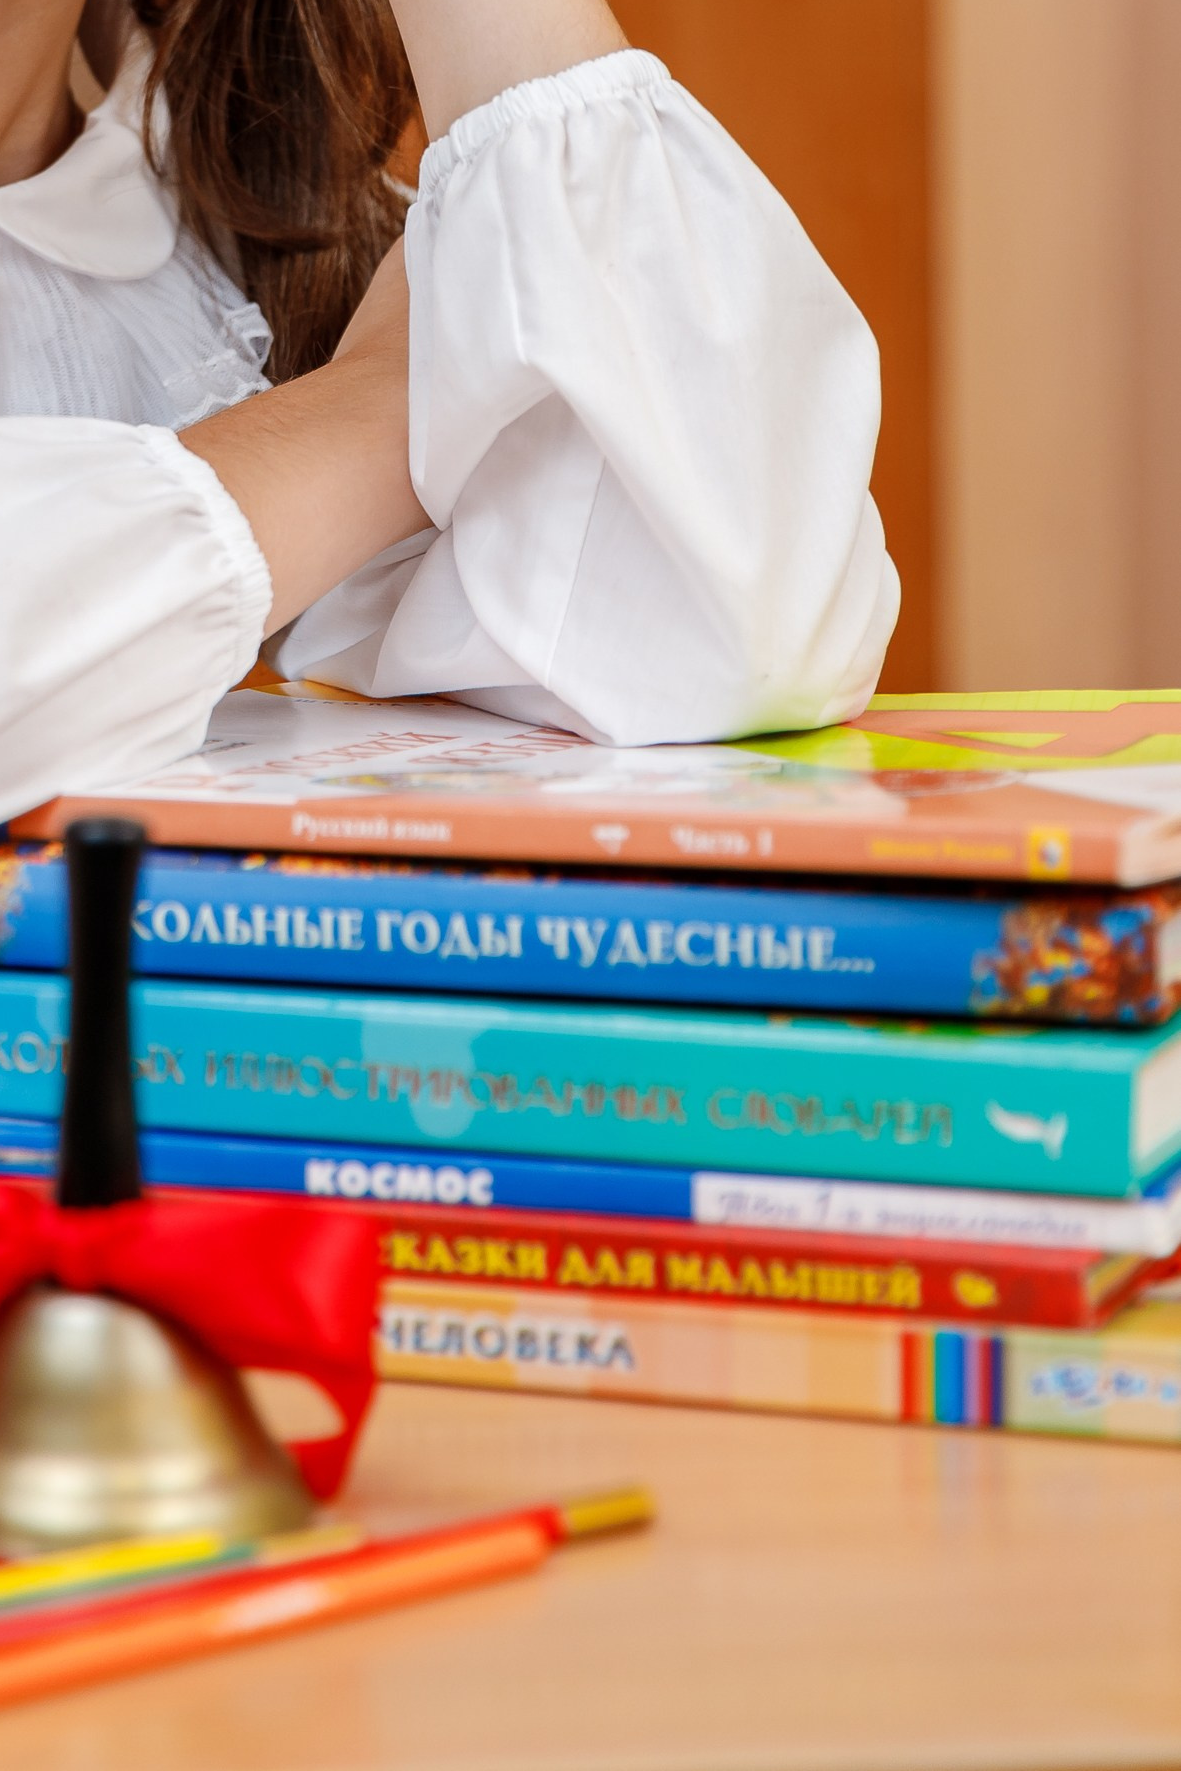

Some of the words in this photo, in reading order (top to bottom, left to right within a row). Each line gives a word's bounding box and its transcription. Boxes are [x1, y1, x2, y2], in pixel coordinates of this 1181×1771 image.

[130, 899, 365, 952] КОЛЬНЫЕ
[376, 908, 522, 961] ГОДЫ
[536, 916, 874, 974] ЧУДЕСНЫЕ...
[305, 1159, 493, 1207] КОСМОС
[558, 1247, 656, 1289] ДЛЯ
[666, 1253, 920, 1308] МАЛЫШЕЙ
